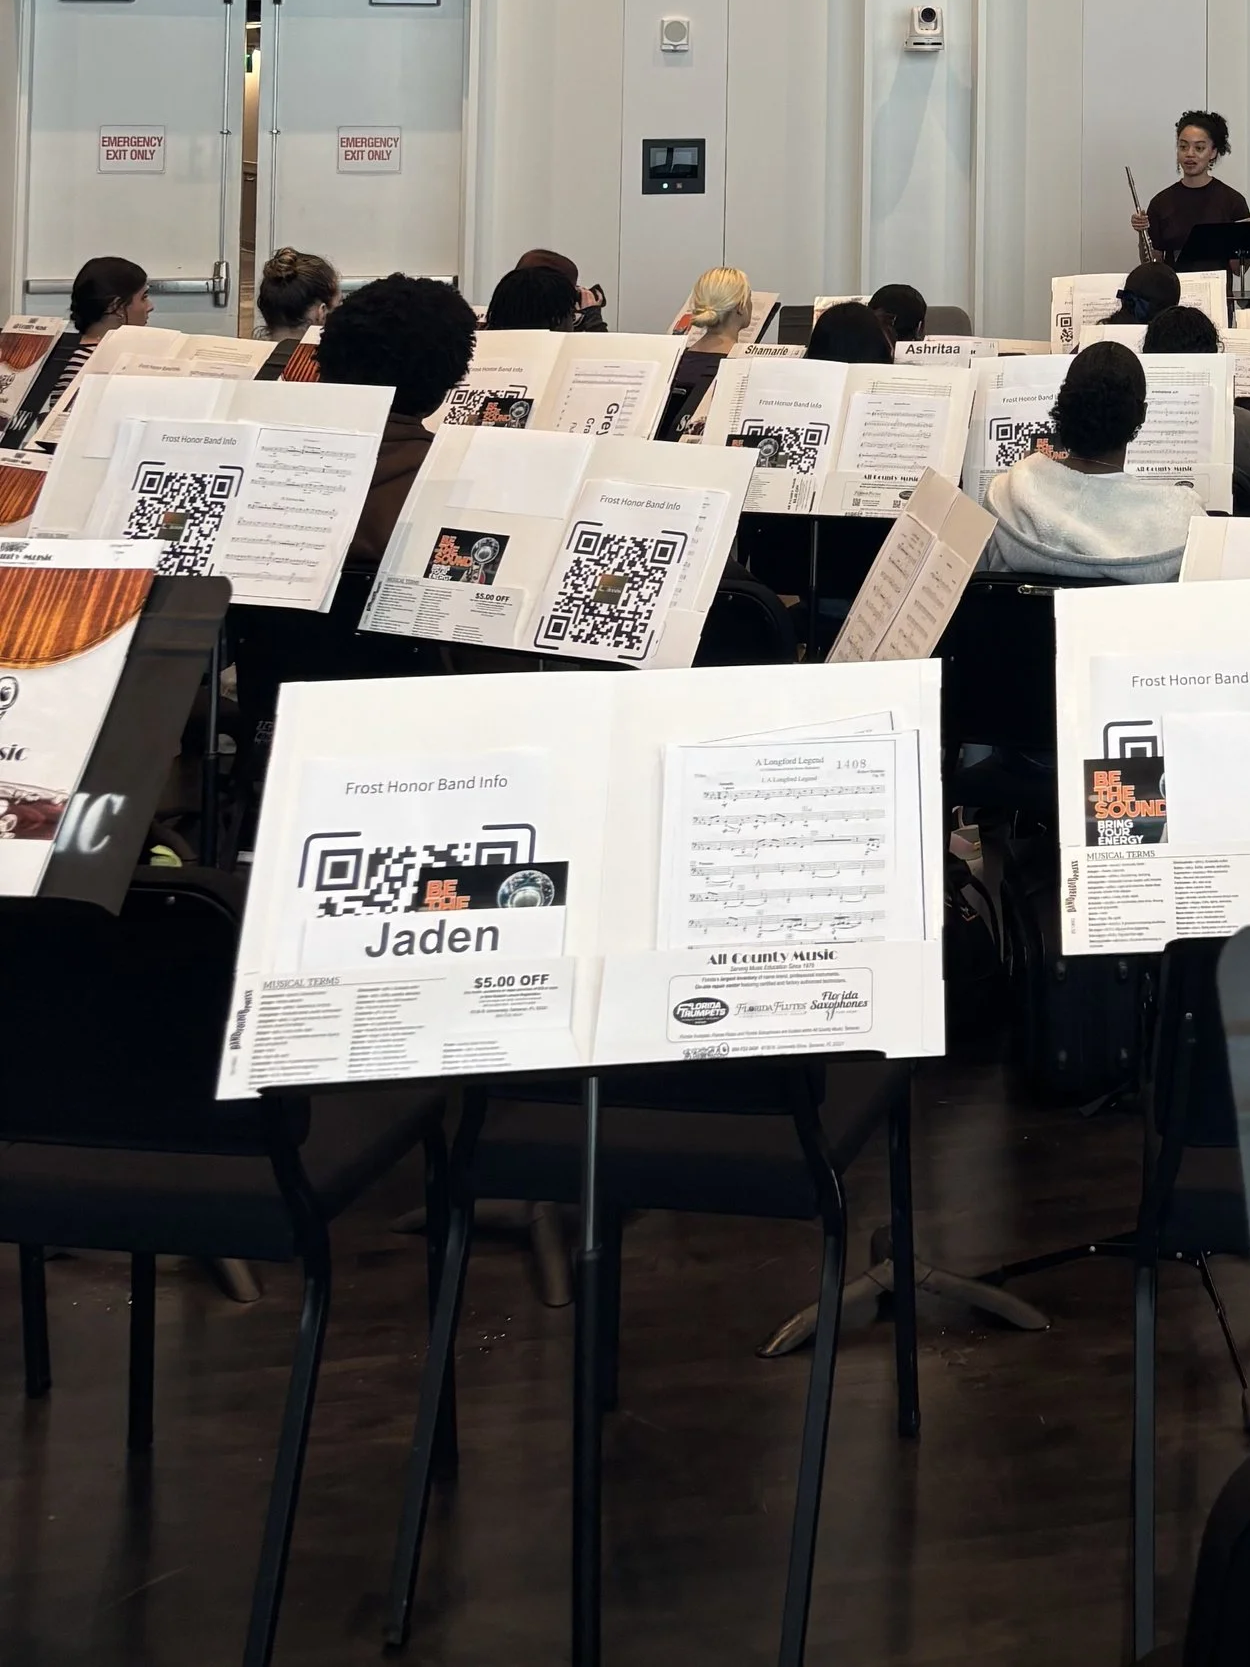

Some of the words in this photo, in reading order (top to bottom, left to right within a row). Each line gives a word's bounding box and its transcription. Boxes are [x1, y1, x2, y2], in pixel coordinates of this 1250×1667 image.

[101, 135, 164, 148] EMERGENCY
[340, 136, 400, 149] EMERGENCY
[105, 149, 126, 161] EXIT
[128, 149, 156, 162] ONLY
[344, 149, 366, 161] EXIT
[367, 149, 392, 162] ONLY
[905, 343, 961, 355] Ashritaa
[162, 433, 181, 443] Frost
[181, 435, 203, 445] Honor
[203, 435, 222, 446] Band
[222, 436, 238, 447] Info
[600, 494, 620, 507] Frost
[620, 497, 645, 509] Honor
[645, 499, 665, 511] Band
[665, 500, 682, 512] Info
[475, 592, 495, 602] $5.00
[495, 594, 510, 603] OFF
[1132, 675, 1167, 688] Frost
[1169, 673, 1212, 686] Honor
[1214, 671, 1249, 684] Band
[764, 757, 797, 768] Longford
[798, 756, 825, 767] Legend
[835, 759, 867, 771] 1408
[345, 782, 384, 795] Frost
[387, 780, 434, 793] Honor
[437, 776, 476, 791] Band
[479, 774, 508, 788] Info
[1093, 770, 1122, 786] BE
[1093, 785, 1136, 802] THE
[1094, 799, 1167, 819] SOUND
[1097, 819, 1134, 830] BRING
[1097, 828, 1131, 837] YOUR
[1097, 835, 1144, 846] ENERGY
[1086, 851, 1125, 861] MUSICAL
[1125, 850, 1156, 859] TERMS
[426, 879, 458, 898] BE
[364, 918, 500, 958] Jaden
[707, 953, 727, 965] All
[731, 950, 788, 964] County
[791, 948, 838, 961] Music
[262, 977, 305, 991] MUSICAL
[307, 975, 341, 987] TERMS
[474, 974, 516, 990] $5.00
[519, 973, 550, 987] OFF
[821, 990, 859, 1001] Florida
[679, 1001, 722, 1014] FLORIDA
[679, 1008, 727, 1018] TRUMPETS
[809, 999, 868, 1014] Saxophones
